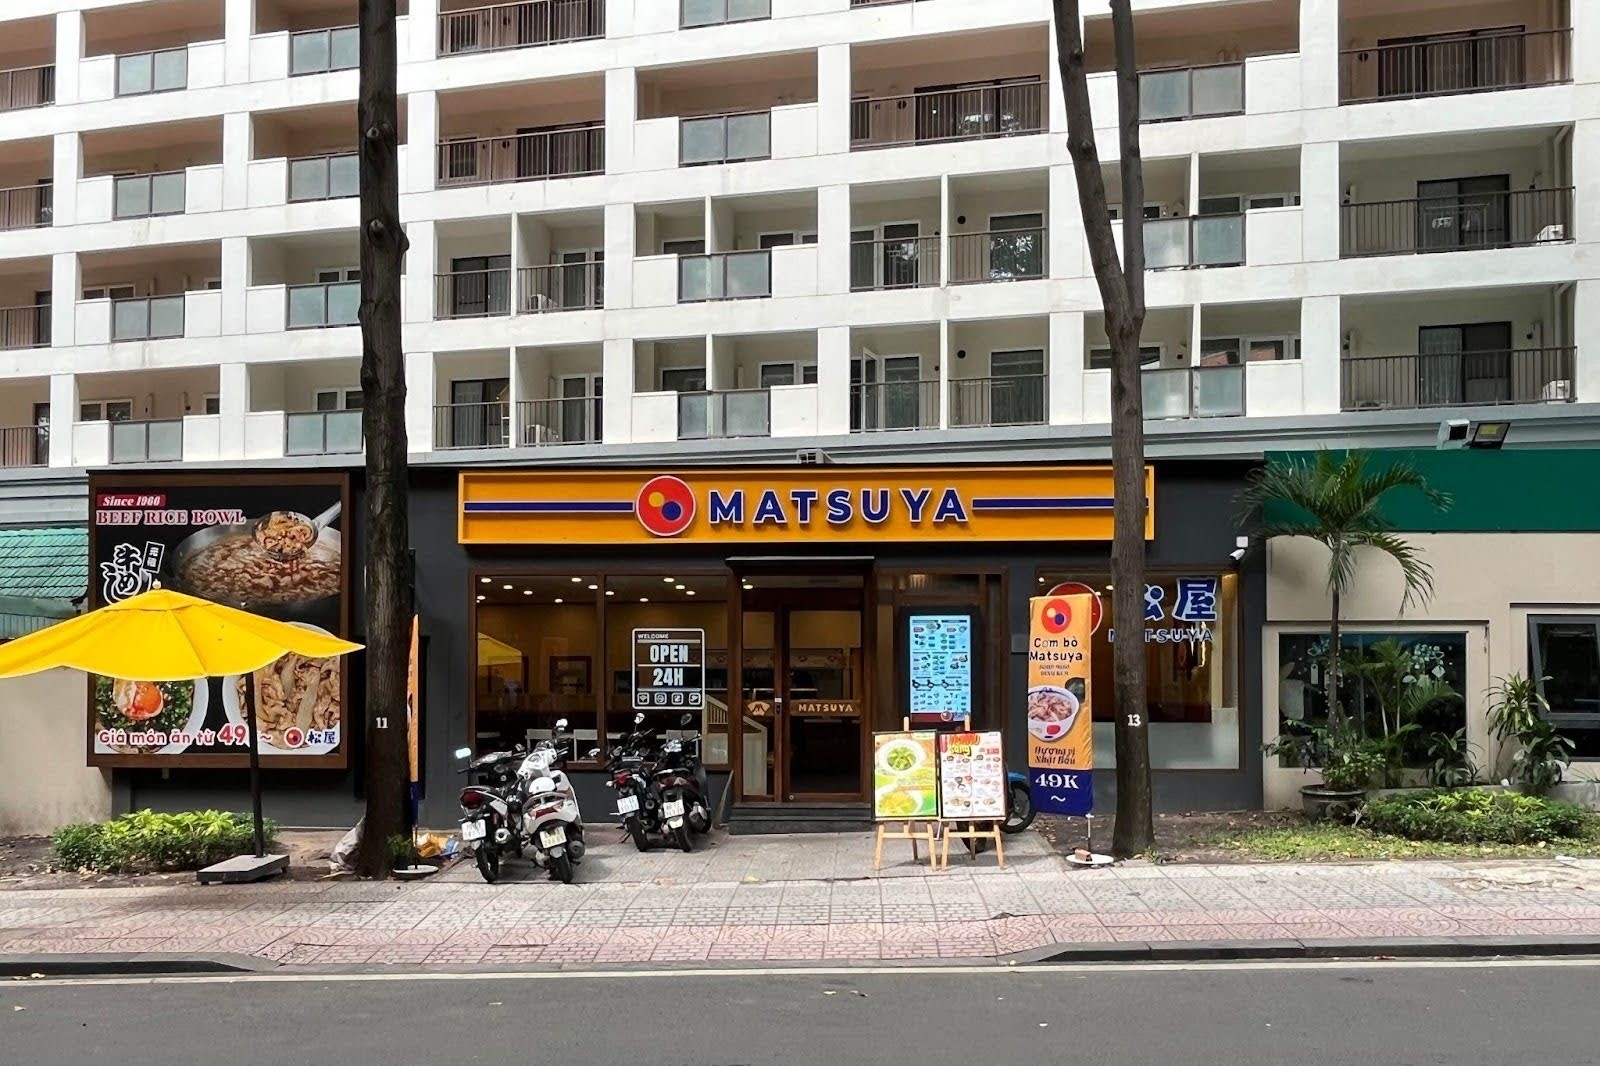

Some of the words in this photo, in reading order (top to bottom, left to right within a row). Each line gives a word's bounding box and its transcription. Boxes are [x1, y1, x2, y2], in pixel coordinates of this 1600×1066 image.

[103, 496, 134, 506] Since
[708, 488, 969, 524] MATSUYA
[97, 510, 142, 525] BEEF
[144, 510, 187, 525] RICE
[191, 510, 246, 525] BOWL
[1063, 636, 1078, 648] bò
[650, 644, 689, 663] OPEN
[1029, 650, 1083, 663] Matsuya
[653, 667, 684, 686] 24H
[798, 703, 853, 712] MATSUYA
[375, 716, 389, 729] 11
[1127, 713, 1142, 727] 13
[132, 729, 164, 743] món
[307, 731, 336, 744] 松屋
[1034, 773, 1080, 790] 49K
